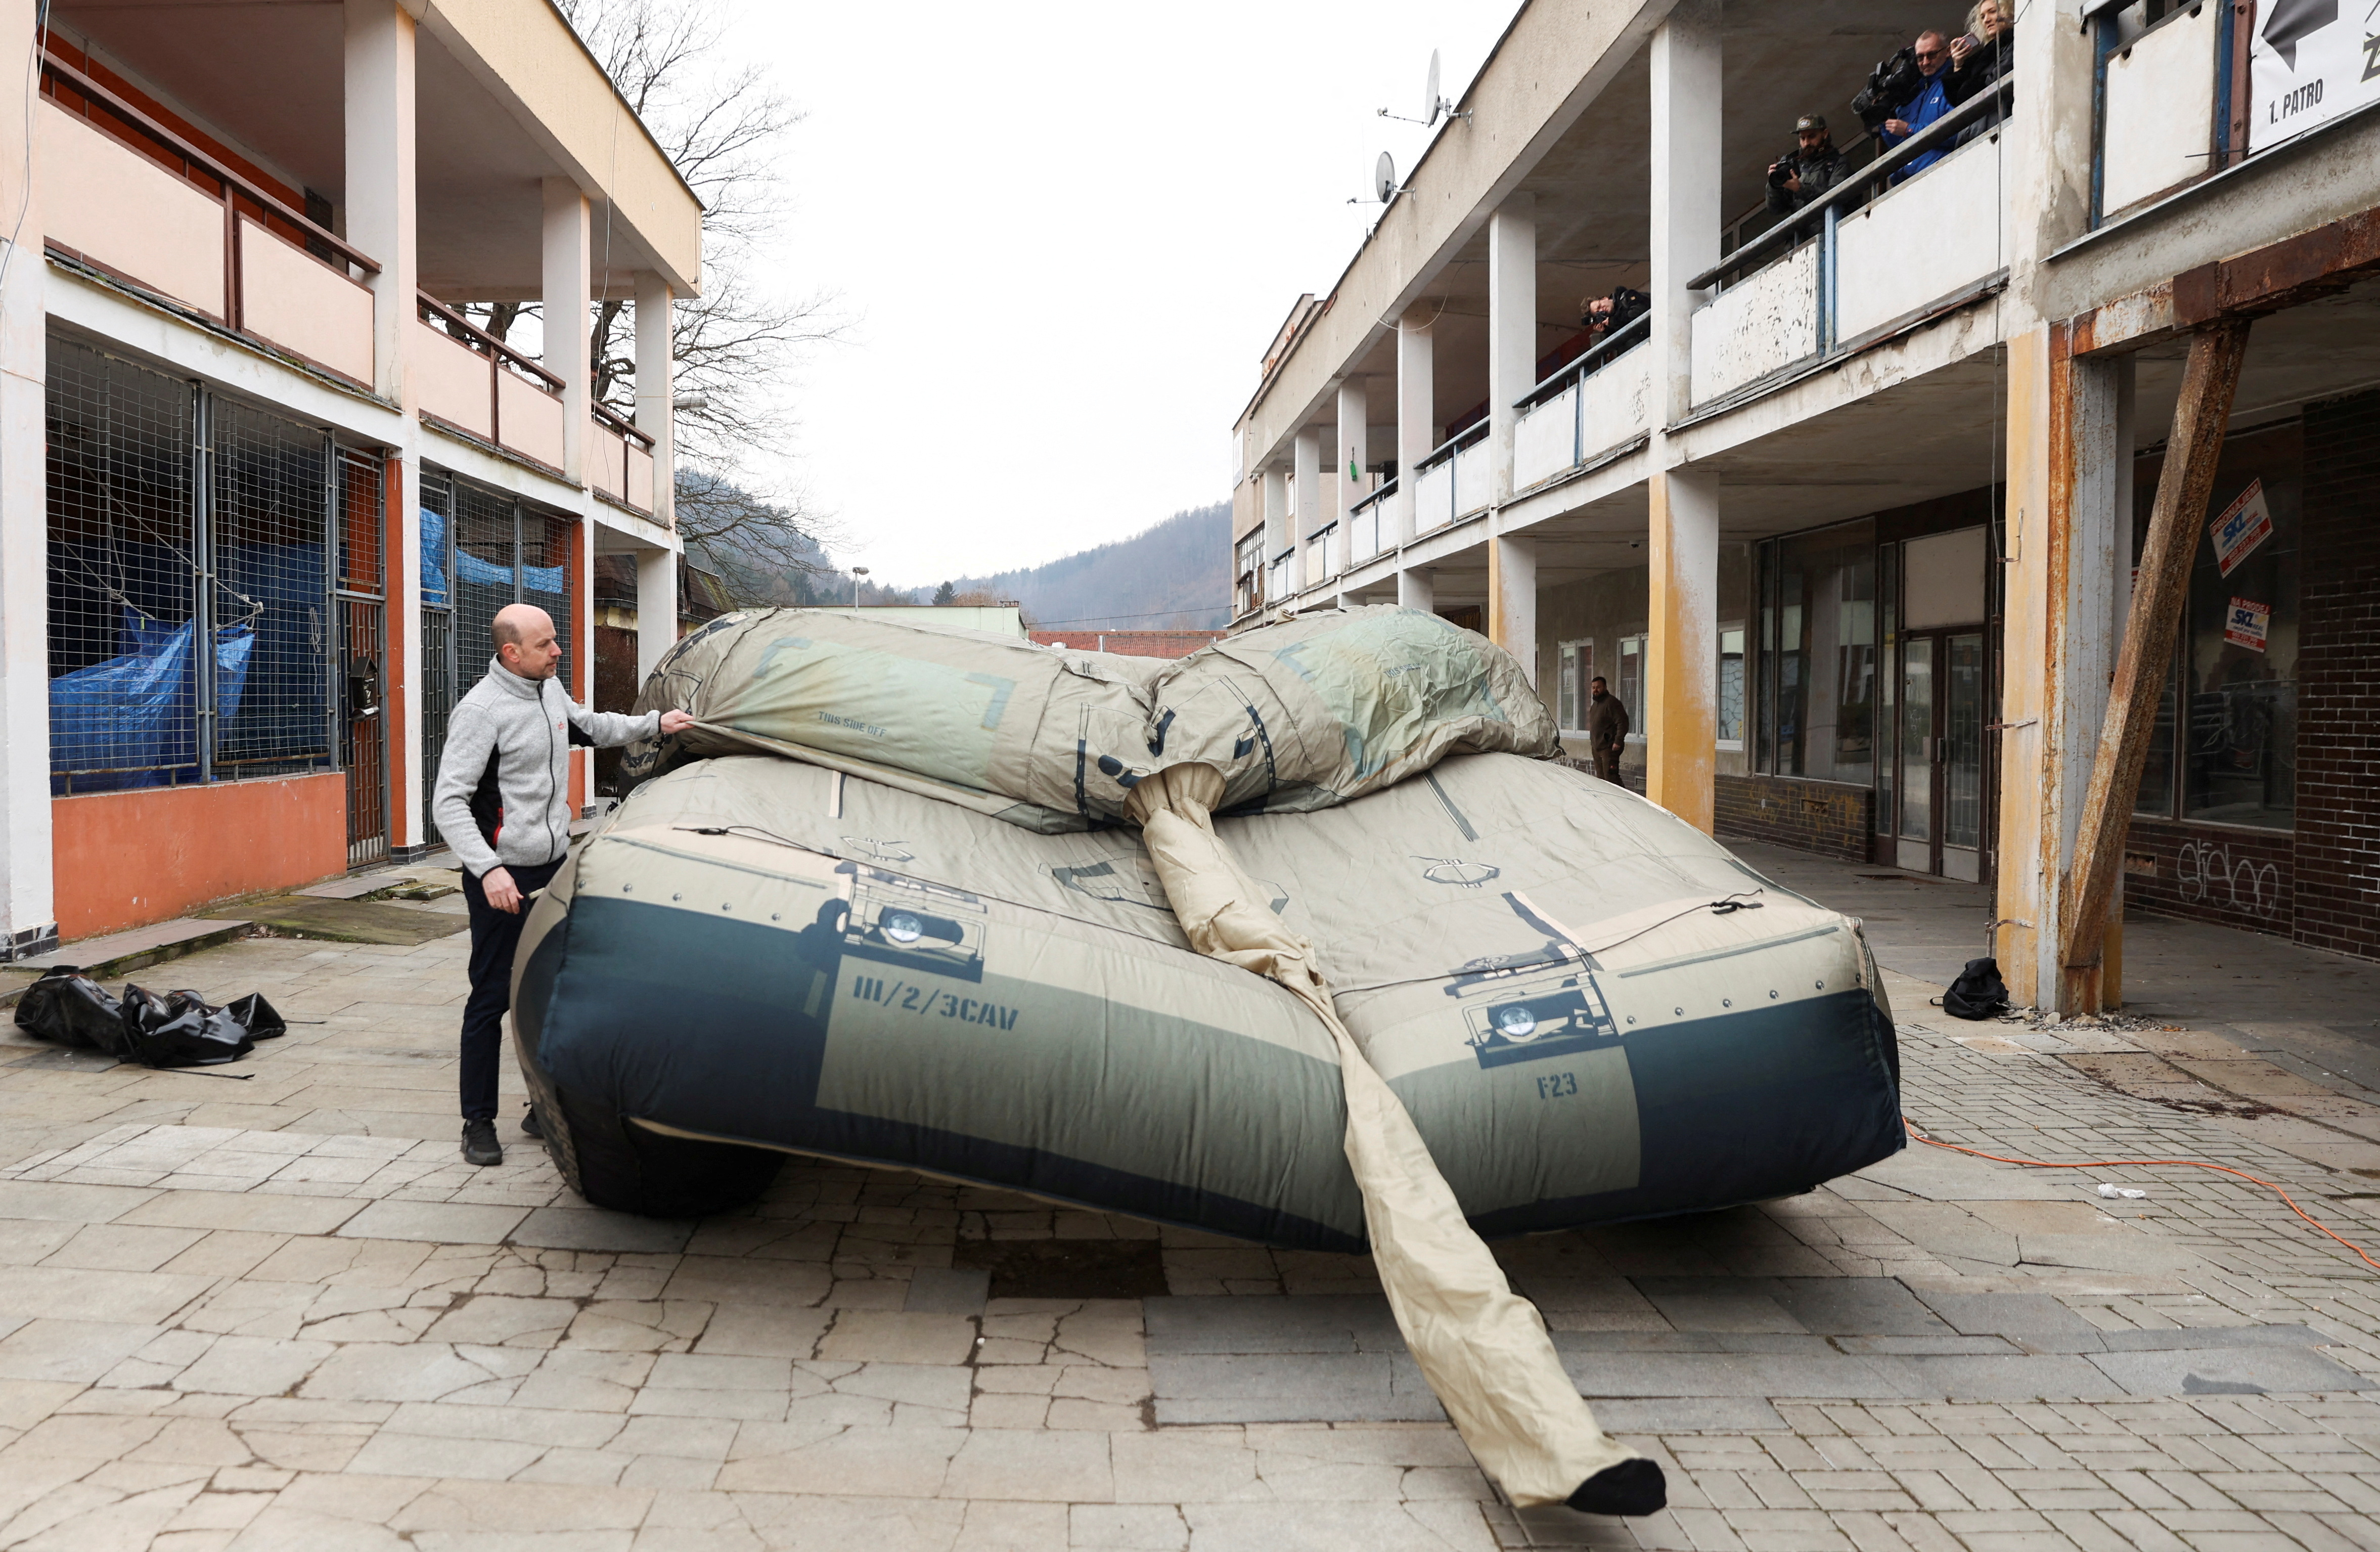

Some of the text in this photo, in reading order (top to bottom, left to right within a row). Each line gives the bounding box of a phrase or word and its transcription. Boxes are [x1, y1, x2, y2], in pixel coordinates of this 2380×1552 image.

[2269, 78, 2323, 125] 1. PATRO
[2231, 597, 2269, 614] NA PRODEJ
[819, 711, 887, 737] THIS SIDE OFF
[853, 975, 1019, 1031] III/2/3CAV
[1536, 1072, 1578, 1099] F23
